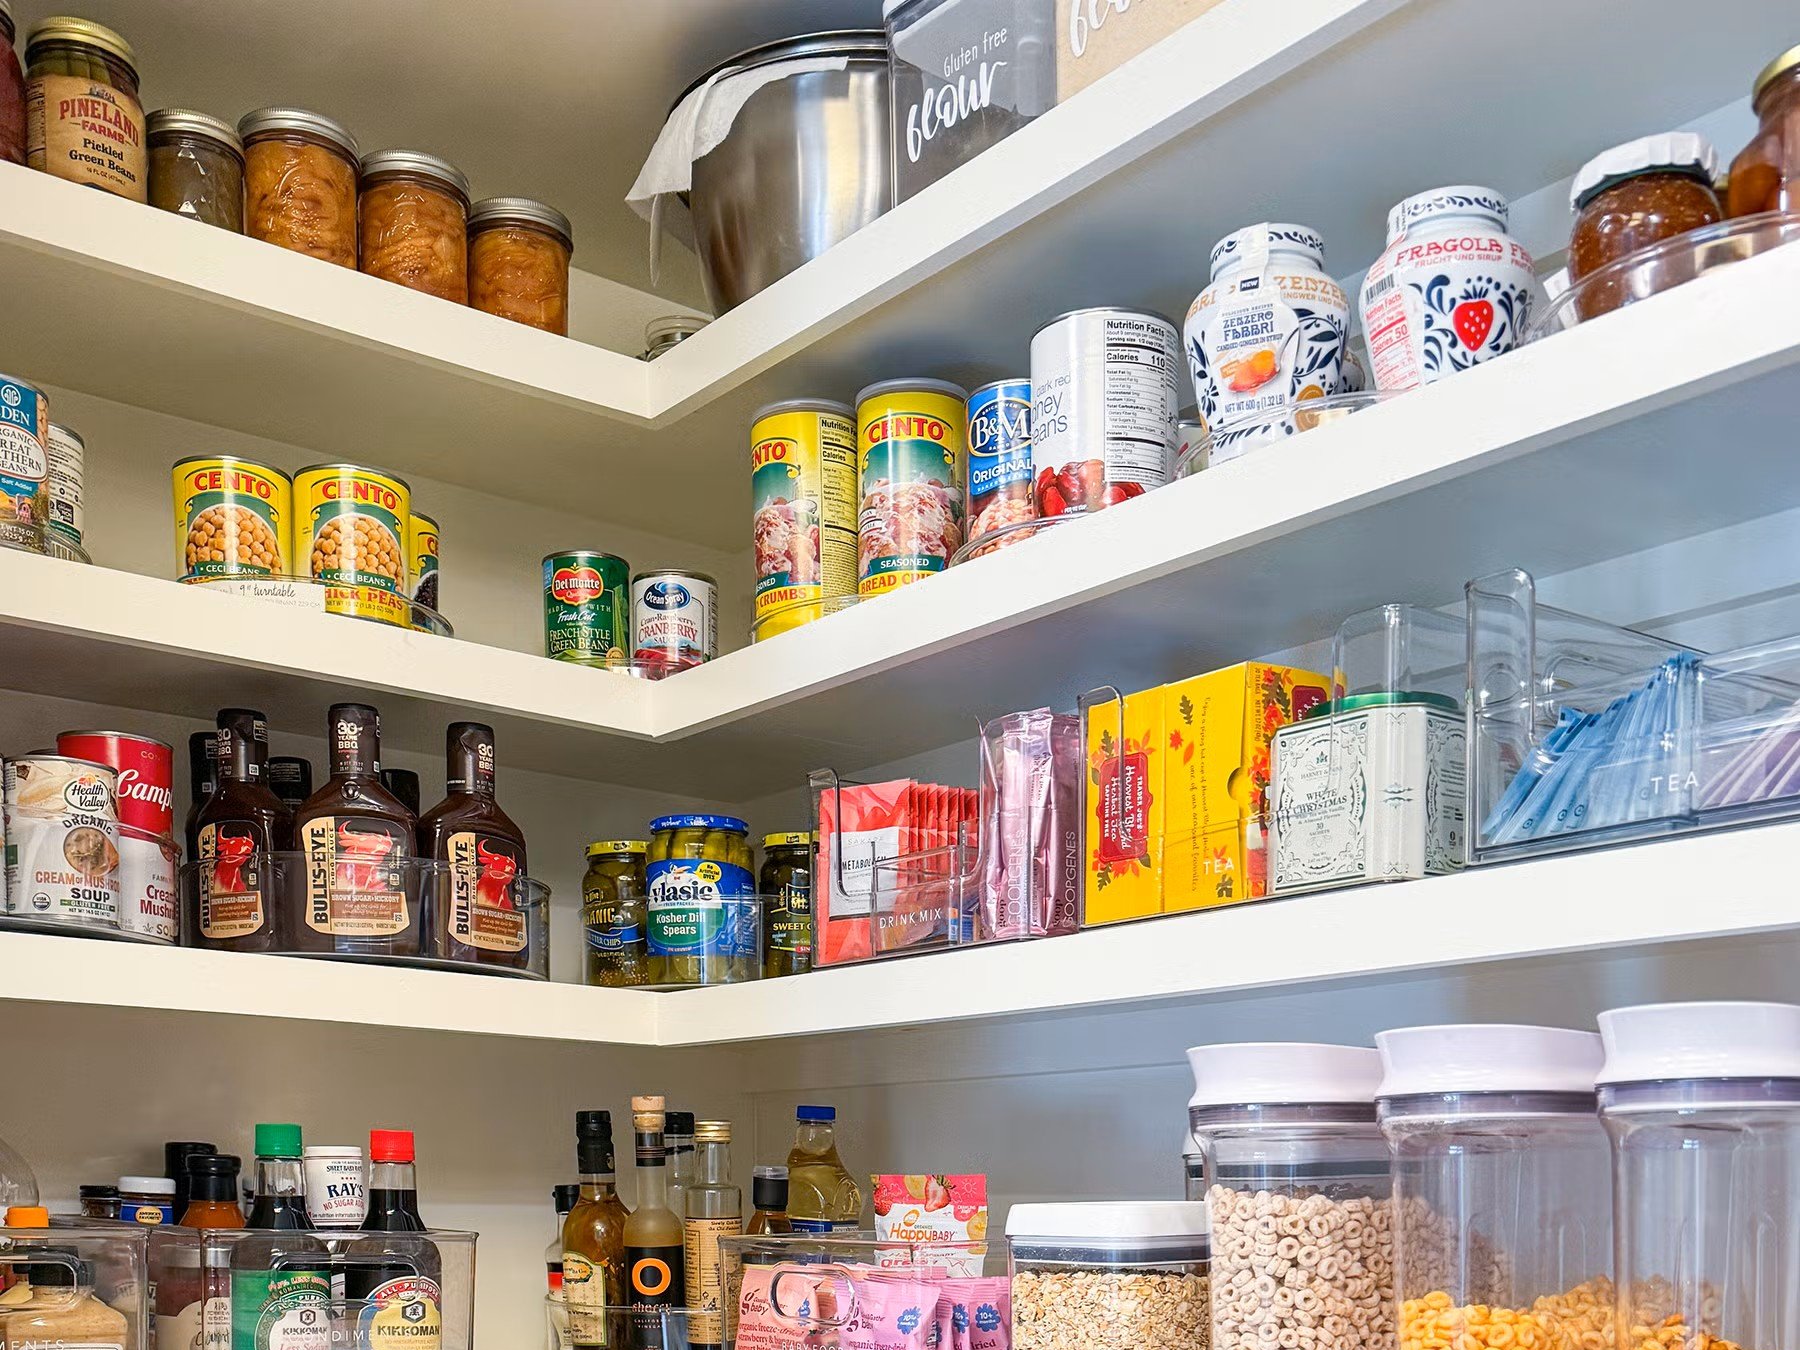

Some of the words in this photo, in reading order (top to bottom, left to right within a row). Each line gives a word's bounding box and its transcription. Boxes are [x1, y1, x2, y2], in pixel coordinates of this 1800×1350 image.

[944, 45, 978, 78] Gluten
[983, 28, 1007, 54] free
[907, 62, 1007, 163] flour
[59, 99, 139, 147] PINELAND
[81, 120, 125, 145] FARMS
[83, 138, 124, 161] Pickled
[69, 150, 105, 167] Green
[108, 162, 136, 182] Beans
[1394, 237, 1503, 267] FRAGOLA
[1241, 279, 1259, 290] NEW
[1106, 321, 1144, 331] Nutrition
[1147, 324, 1165, 337] Facts
[1395, 324, 1408, 340] 50
[1106, 353, 1139, 361] Calories
[1151, 355, 1166, 367] 110
[868, 417, 945, 444] CENTO
[974, 408, 1032, 450] B&M
[972, 459, 1032, 484] ORIGINAL
[195, 472, 271, 499] CENTO
[322, 481, 397, 510] CENTO
[880, 557, 930, 568] SEASONED
[357, 576, 386, 587] BEANS
[861, 575, 897, 594] BREAD
[760, 588, 807, 608] CRUMBS
[549, 629, 580, 641] FRENCH
[581, 626, 611, 640] STYLE
[638, 622, 698, 643] CRANBERRY
[550, 640, 577, 653] GREEN
[578, 638, 609, 651] BEANS
[338, 741, 358, 750] BBQ
[478, 761, 493, 771] BBQ
[71, 783, 104, 798] Health
[1125, 765, 1136, 812] Harvest
[1651, 773, 1698, 794] TEA
[79, 793, 107, 810] Valley
[1307, 789, 1338, 801] WHITE
[1293, 796, 1347, 814] CHRISTMAS
[311, 827, 329, 924] BULL'S-EYE
[1203, 860, 1235, 875] TEA
[36, 871, 74, 885] CREAM
[1007, 830, 1026, 927] GOOPGENES
[1062, 831, 1077, 928] GOOPGENES
[70, 887, 110, 902] SOUP
[456, 841, 469, 936] BULL'S-EYE
[656, 913, 687, 924] Kosher
[773, 923, 805, 931] SWEET
[879, 913, 916, 929] DRINK
[918, 908, 942, 921] MIX
[663, 925, 696, 937] Spears
[327, 1183, 363, 1198] RAY'S
[632, 1302, 672, 1314] sherry
[377, 1325, 441, 1336] KIKKOMAN
[738, 1323, 757, 1333] organic
[738, 1333, 768, 1345] strawberry
